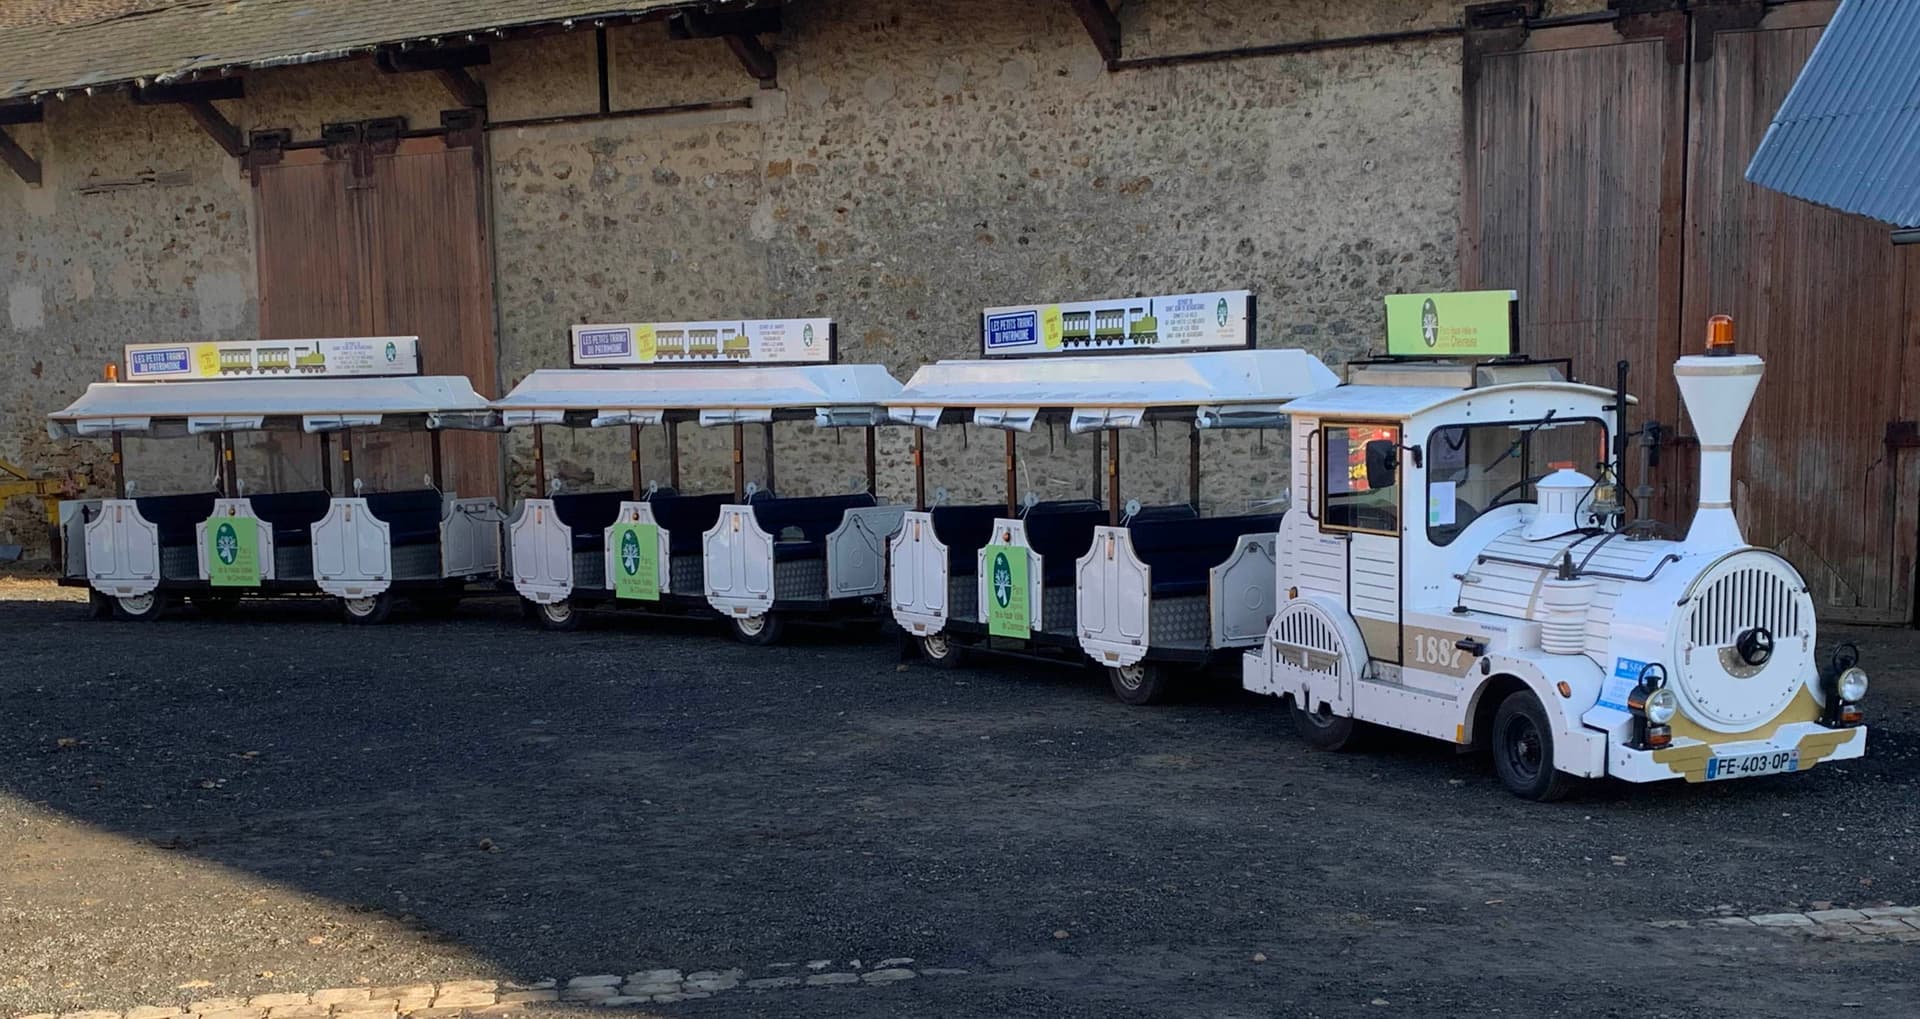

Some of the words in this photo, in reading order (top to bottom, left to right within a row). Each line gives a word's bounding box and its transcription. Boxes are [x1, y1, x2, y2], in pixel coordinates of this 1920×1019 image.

[991, 320, 999, 331] LES
[1000, 318, 1016, 330] PETITS
[1017, 316, 1034, 328] TRAINS
[583, 335, 592, 345] LES
[592, 334, 609, 344] PETITS
[610, 333, 626, 343] TRAINS
[995, 332, 1002, 343] DU
[1002, 329, 1029, 342] PATRIMOINE
[587, 345, 593, 354] DU
[594, 343, 623, 354] PATRIMOINE
[134, 354, 145, 364] LES
[146, 352, 165, 363] PETITS
[166, 351, 185, 361] TRAINS
[140, 363, 147, 372] DU
[148, 361, 181, 372] PATRIMOINE
